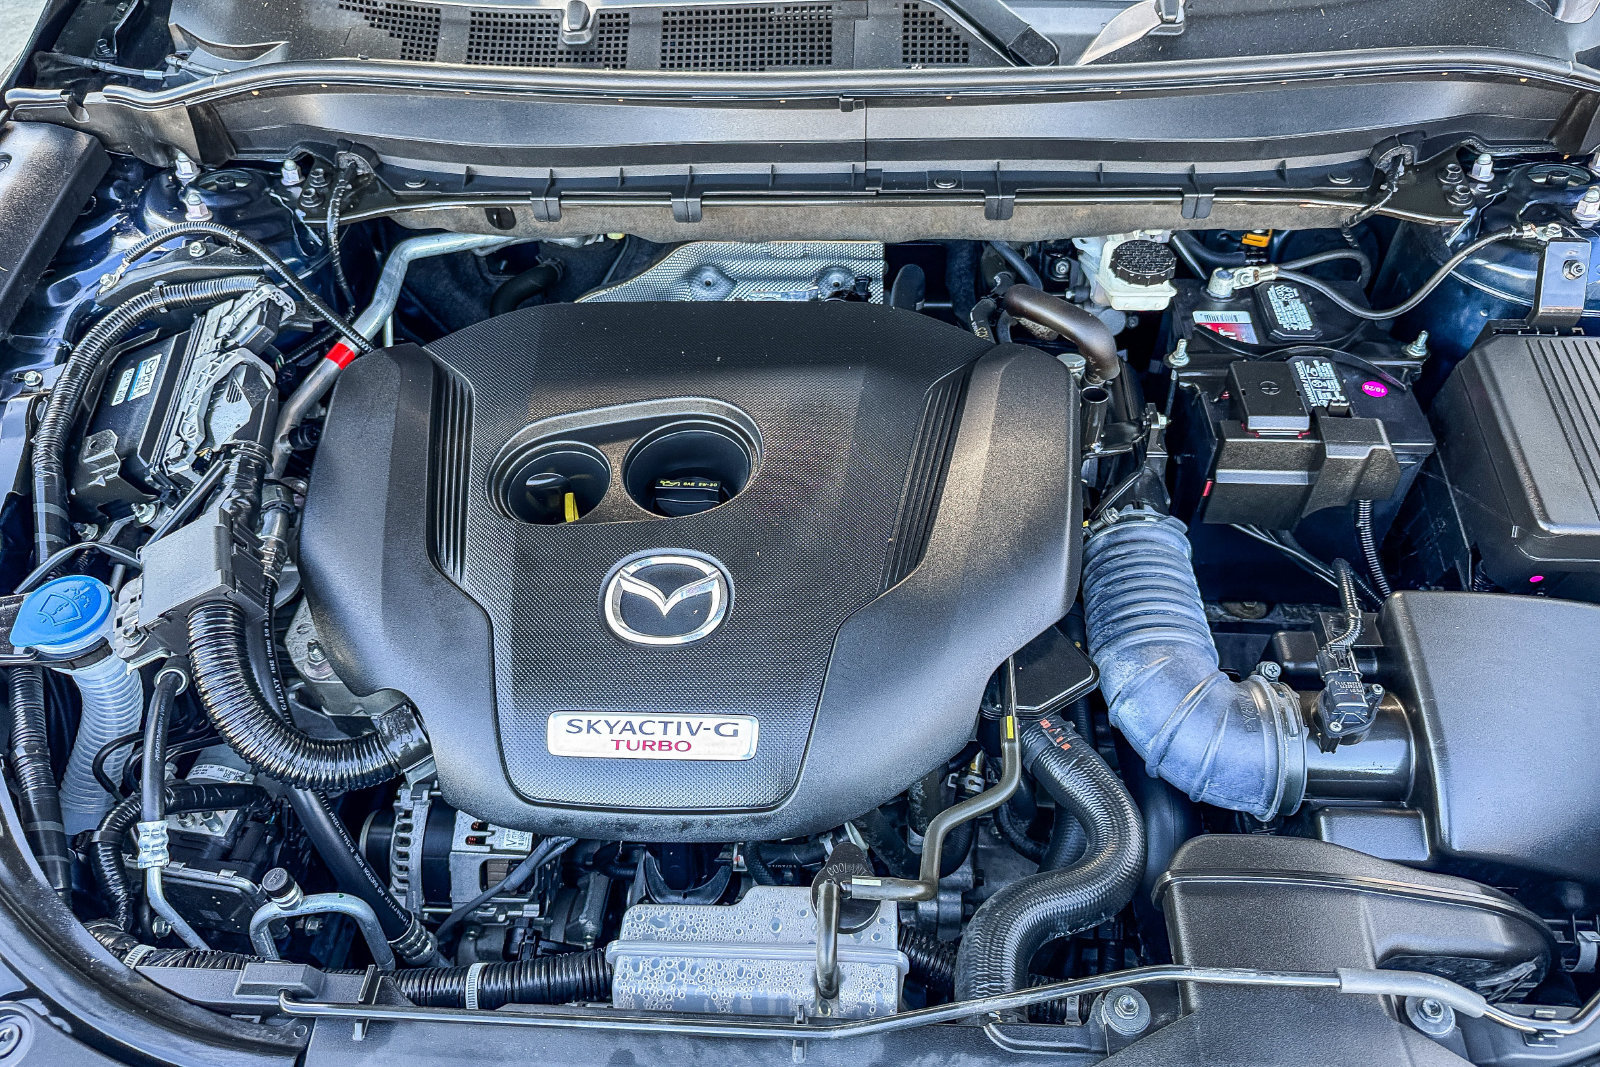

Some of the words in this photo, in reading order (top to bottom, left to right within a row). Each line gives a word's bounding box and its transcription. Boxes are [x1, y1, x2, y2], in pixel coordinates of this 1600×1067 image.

[273, 677, 288, 710] GALAXY
[565, 718, 740, 738] SKYACTIV-G
[611, 739, 692, 752] TURBO
[353, 853, 365, 868] HOSE
[826, 862, 868, 876] COOLANT
[363, 867, 380, 889] SUCTION
